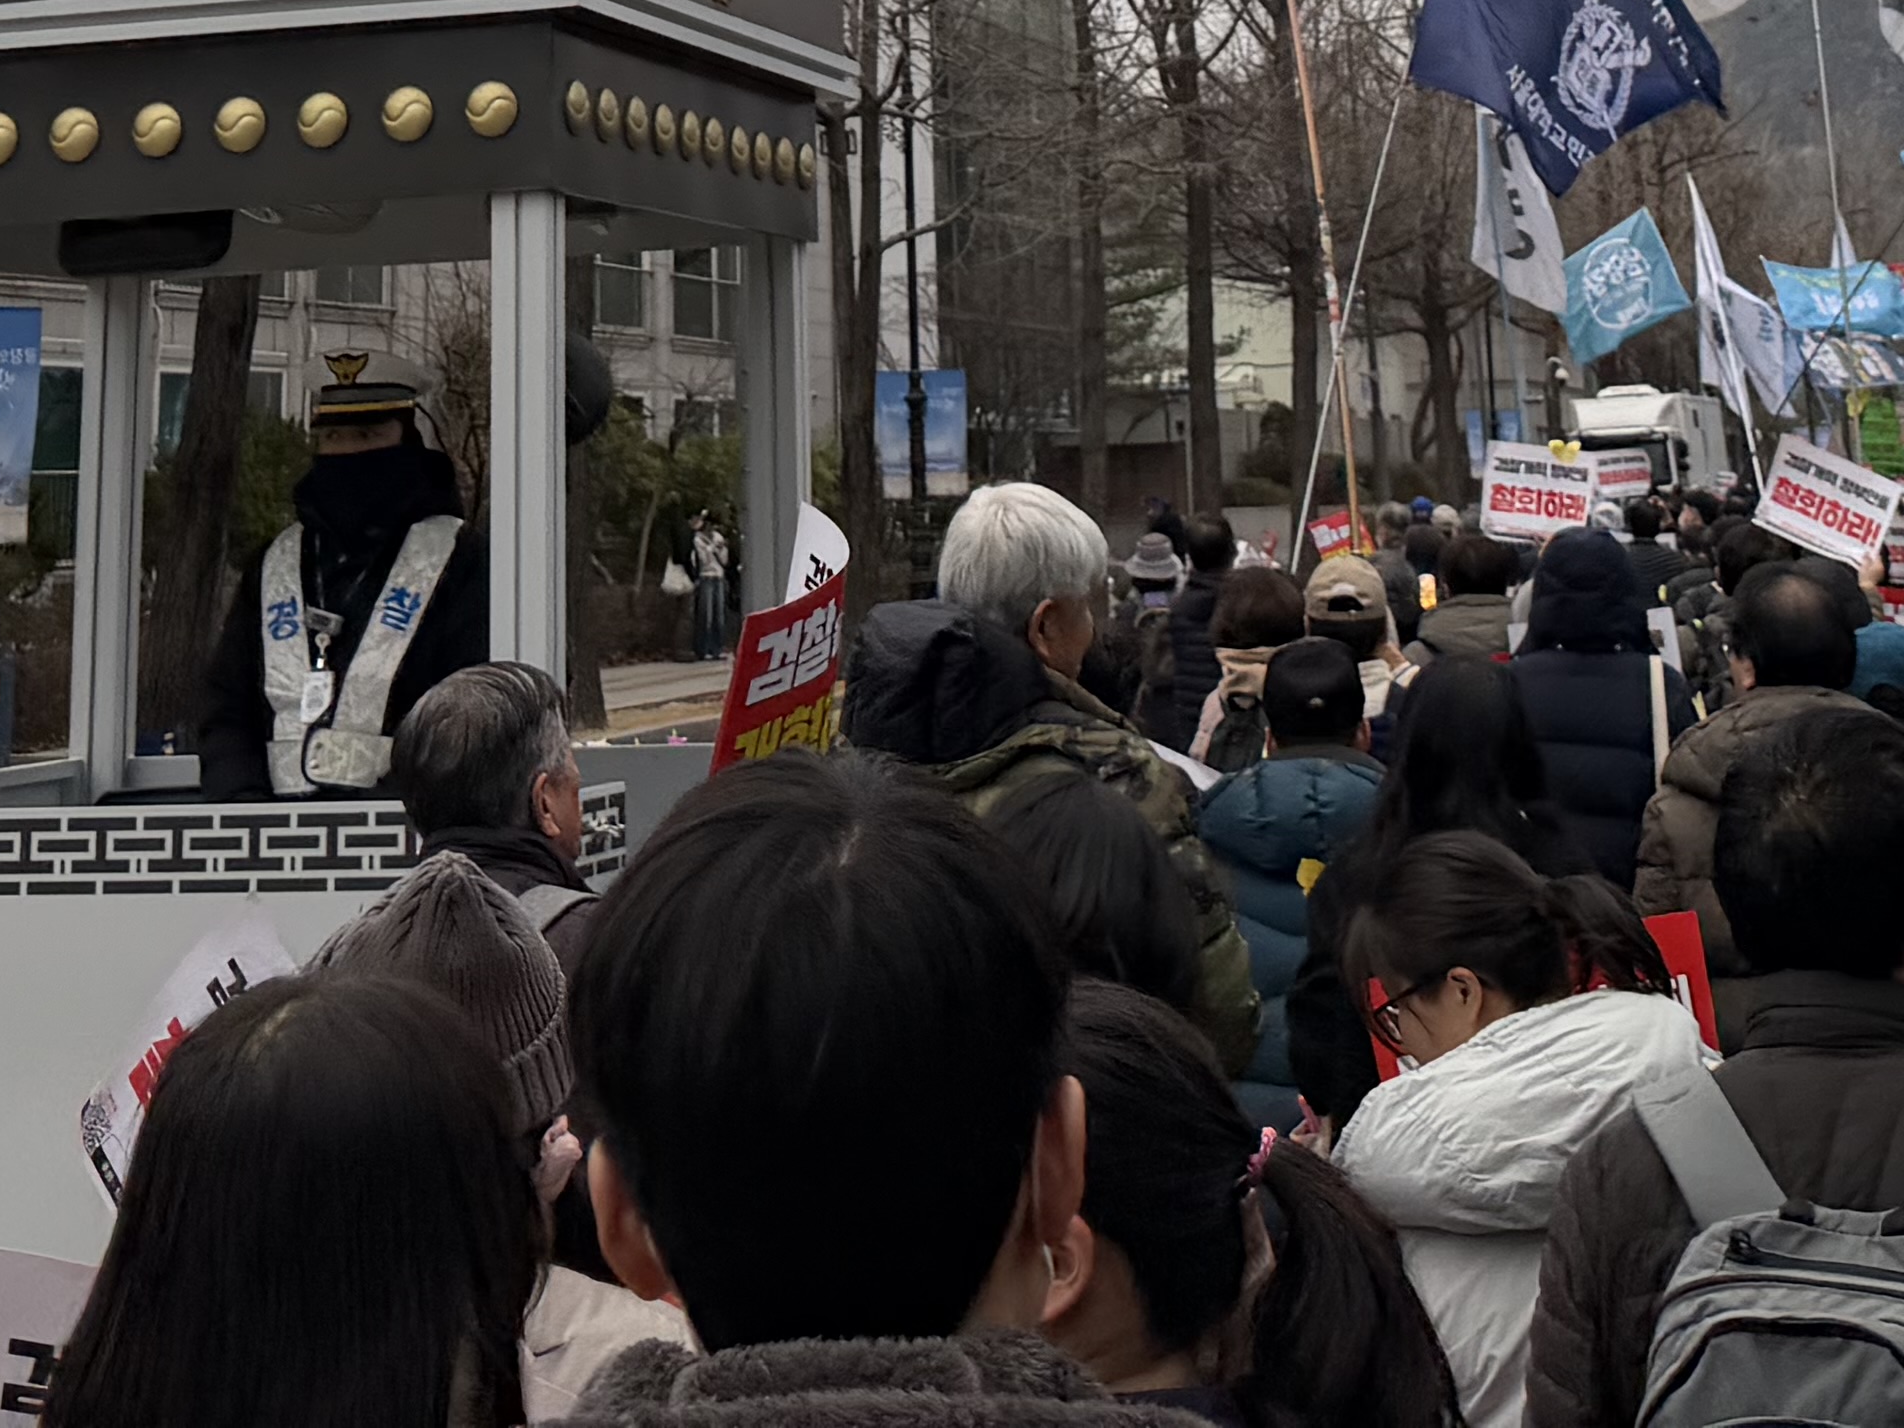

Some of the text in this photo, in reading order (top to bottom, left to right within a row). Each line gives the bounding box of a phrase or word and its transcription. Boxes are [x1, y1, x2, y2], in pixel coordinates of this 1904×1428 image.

[1770, 475, 1882, 546] 철회하라!
[266, 585, 424, 642] 경 찰
[745, 597, 842, 707] 검찰
